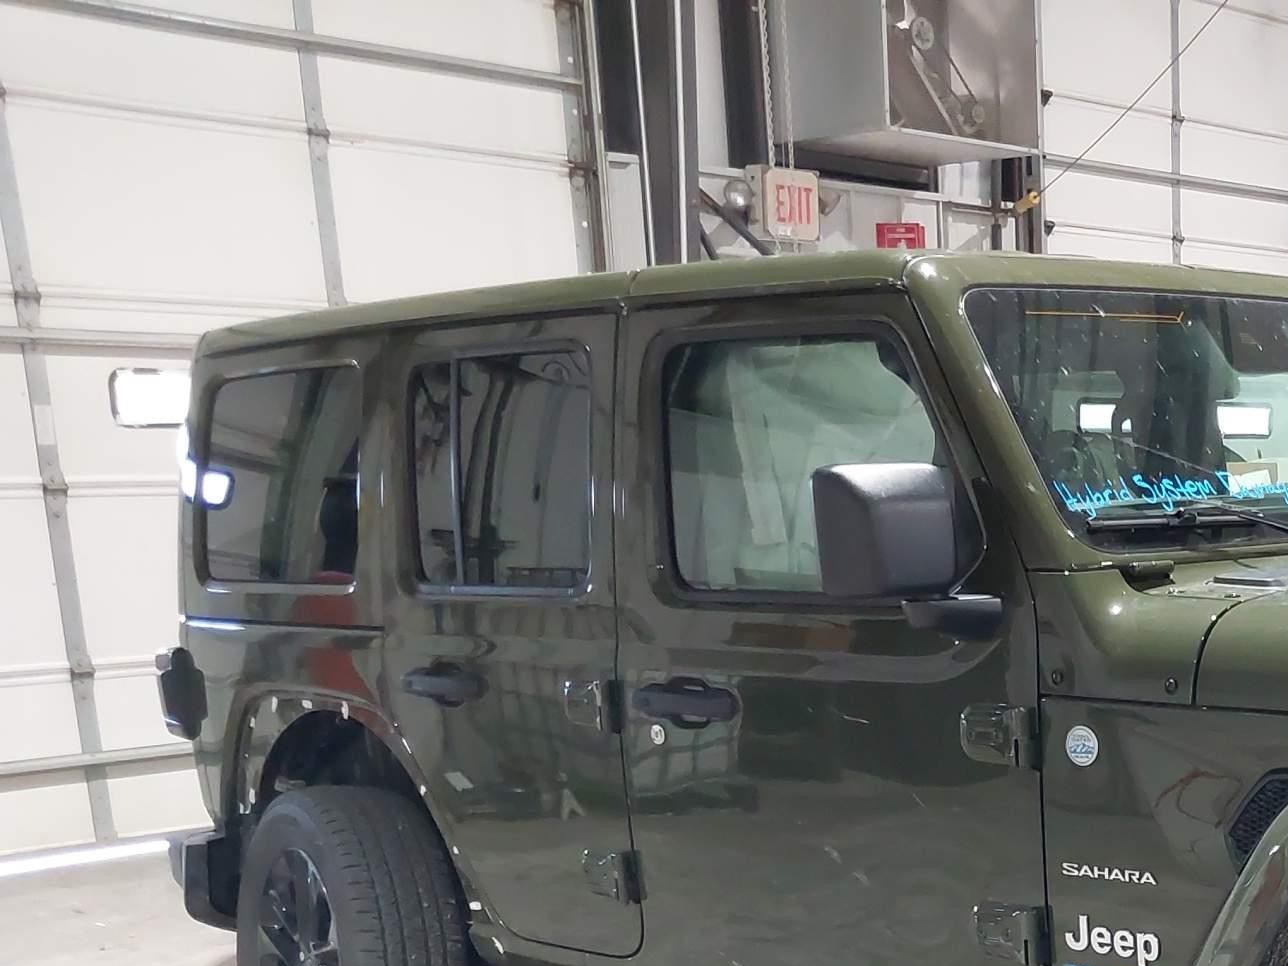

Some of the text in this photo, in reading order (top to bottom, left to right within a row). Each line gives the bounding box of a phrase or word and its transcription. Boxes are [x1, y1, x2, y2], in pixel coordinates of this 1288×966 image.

[775, 184, 812, 225] EXIT
[1053, 476, 1135, 520] Hybrid
[1132, 471, 1217, 512] System
[1062, 862, 1157, 886] SAHARA
